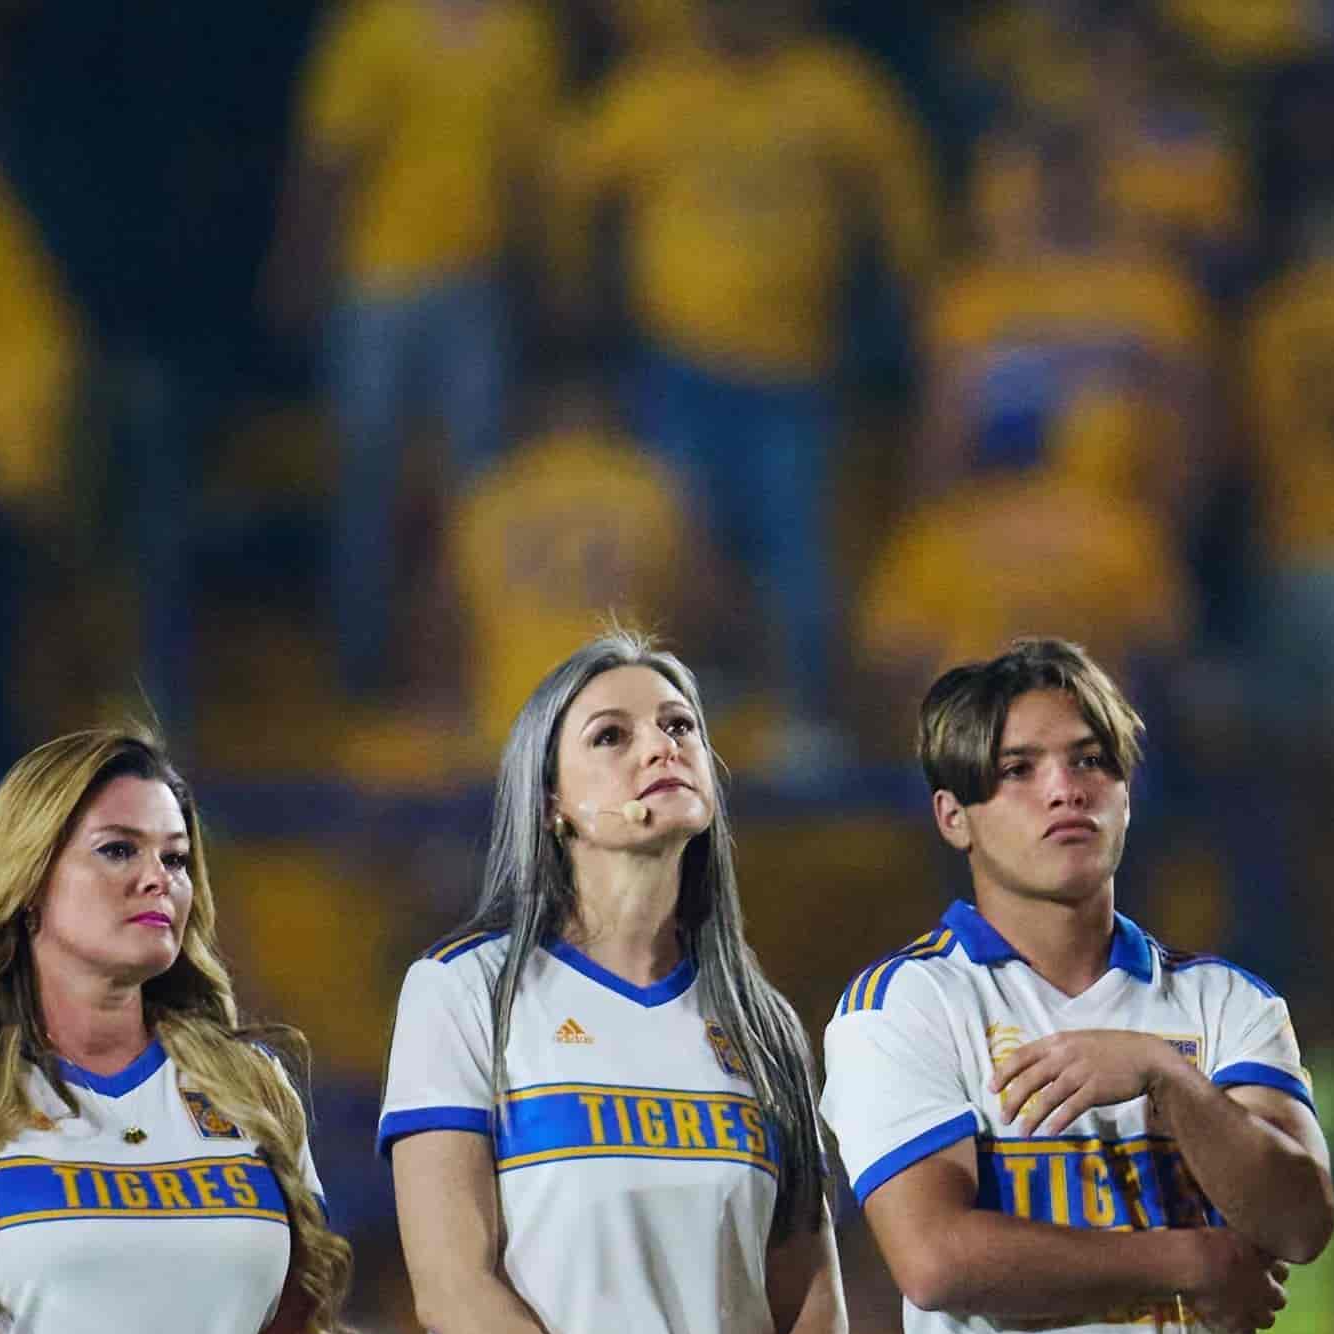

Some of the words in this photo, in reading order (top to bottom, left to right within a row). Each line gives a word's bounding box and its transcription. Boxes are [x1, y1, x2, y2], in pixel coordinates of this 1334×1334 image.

[579, 1094, 766, 1154] TIGRES
[53, 1165, 260, 1209] TIGRES
[1003, 1154, 1187, 1229] TIG
